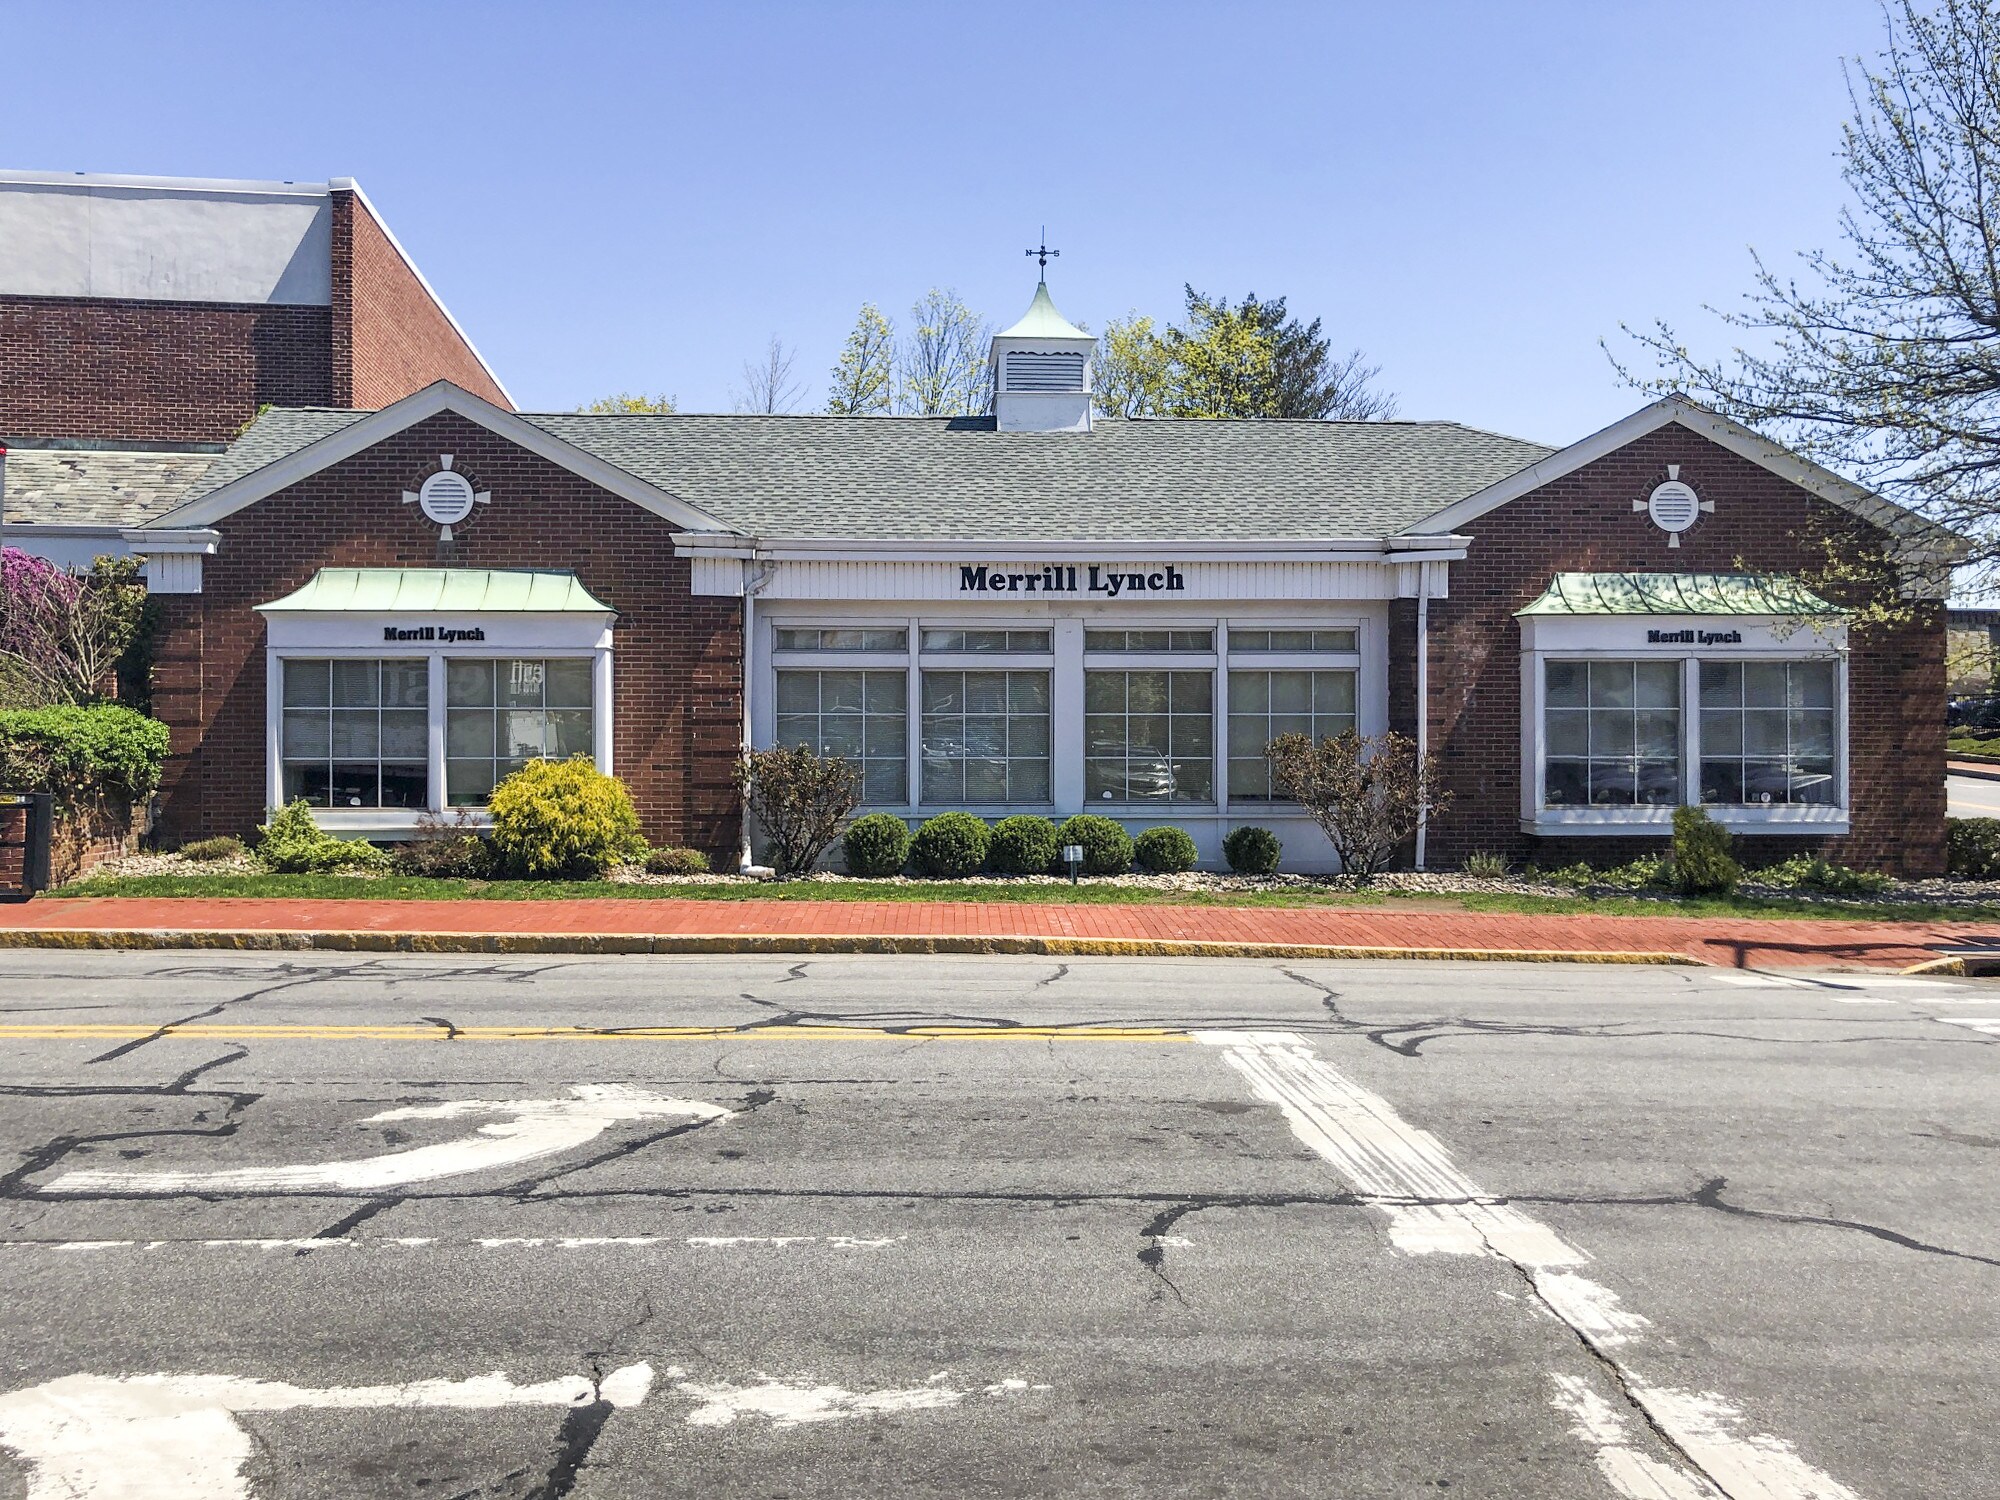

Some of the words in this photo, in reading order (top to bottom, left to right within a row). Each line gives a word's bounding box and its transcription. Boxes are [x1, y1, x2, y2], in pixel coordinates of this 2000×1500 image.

[960, 566, 1077, 591] Merrill
[1088, 566, 1184, 597] Lynch
[384, 627, 435, 640] Merrill
[438, 626, 485, 643] Lynch
[1647, 630, 1694, 643] Merrill
[1698, 630, 1742, 645] Lynch
